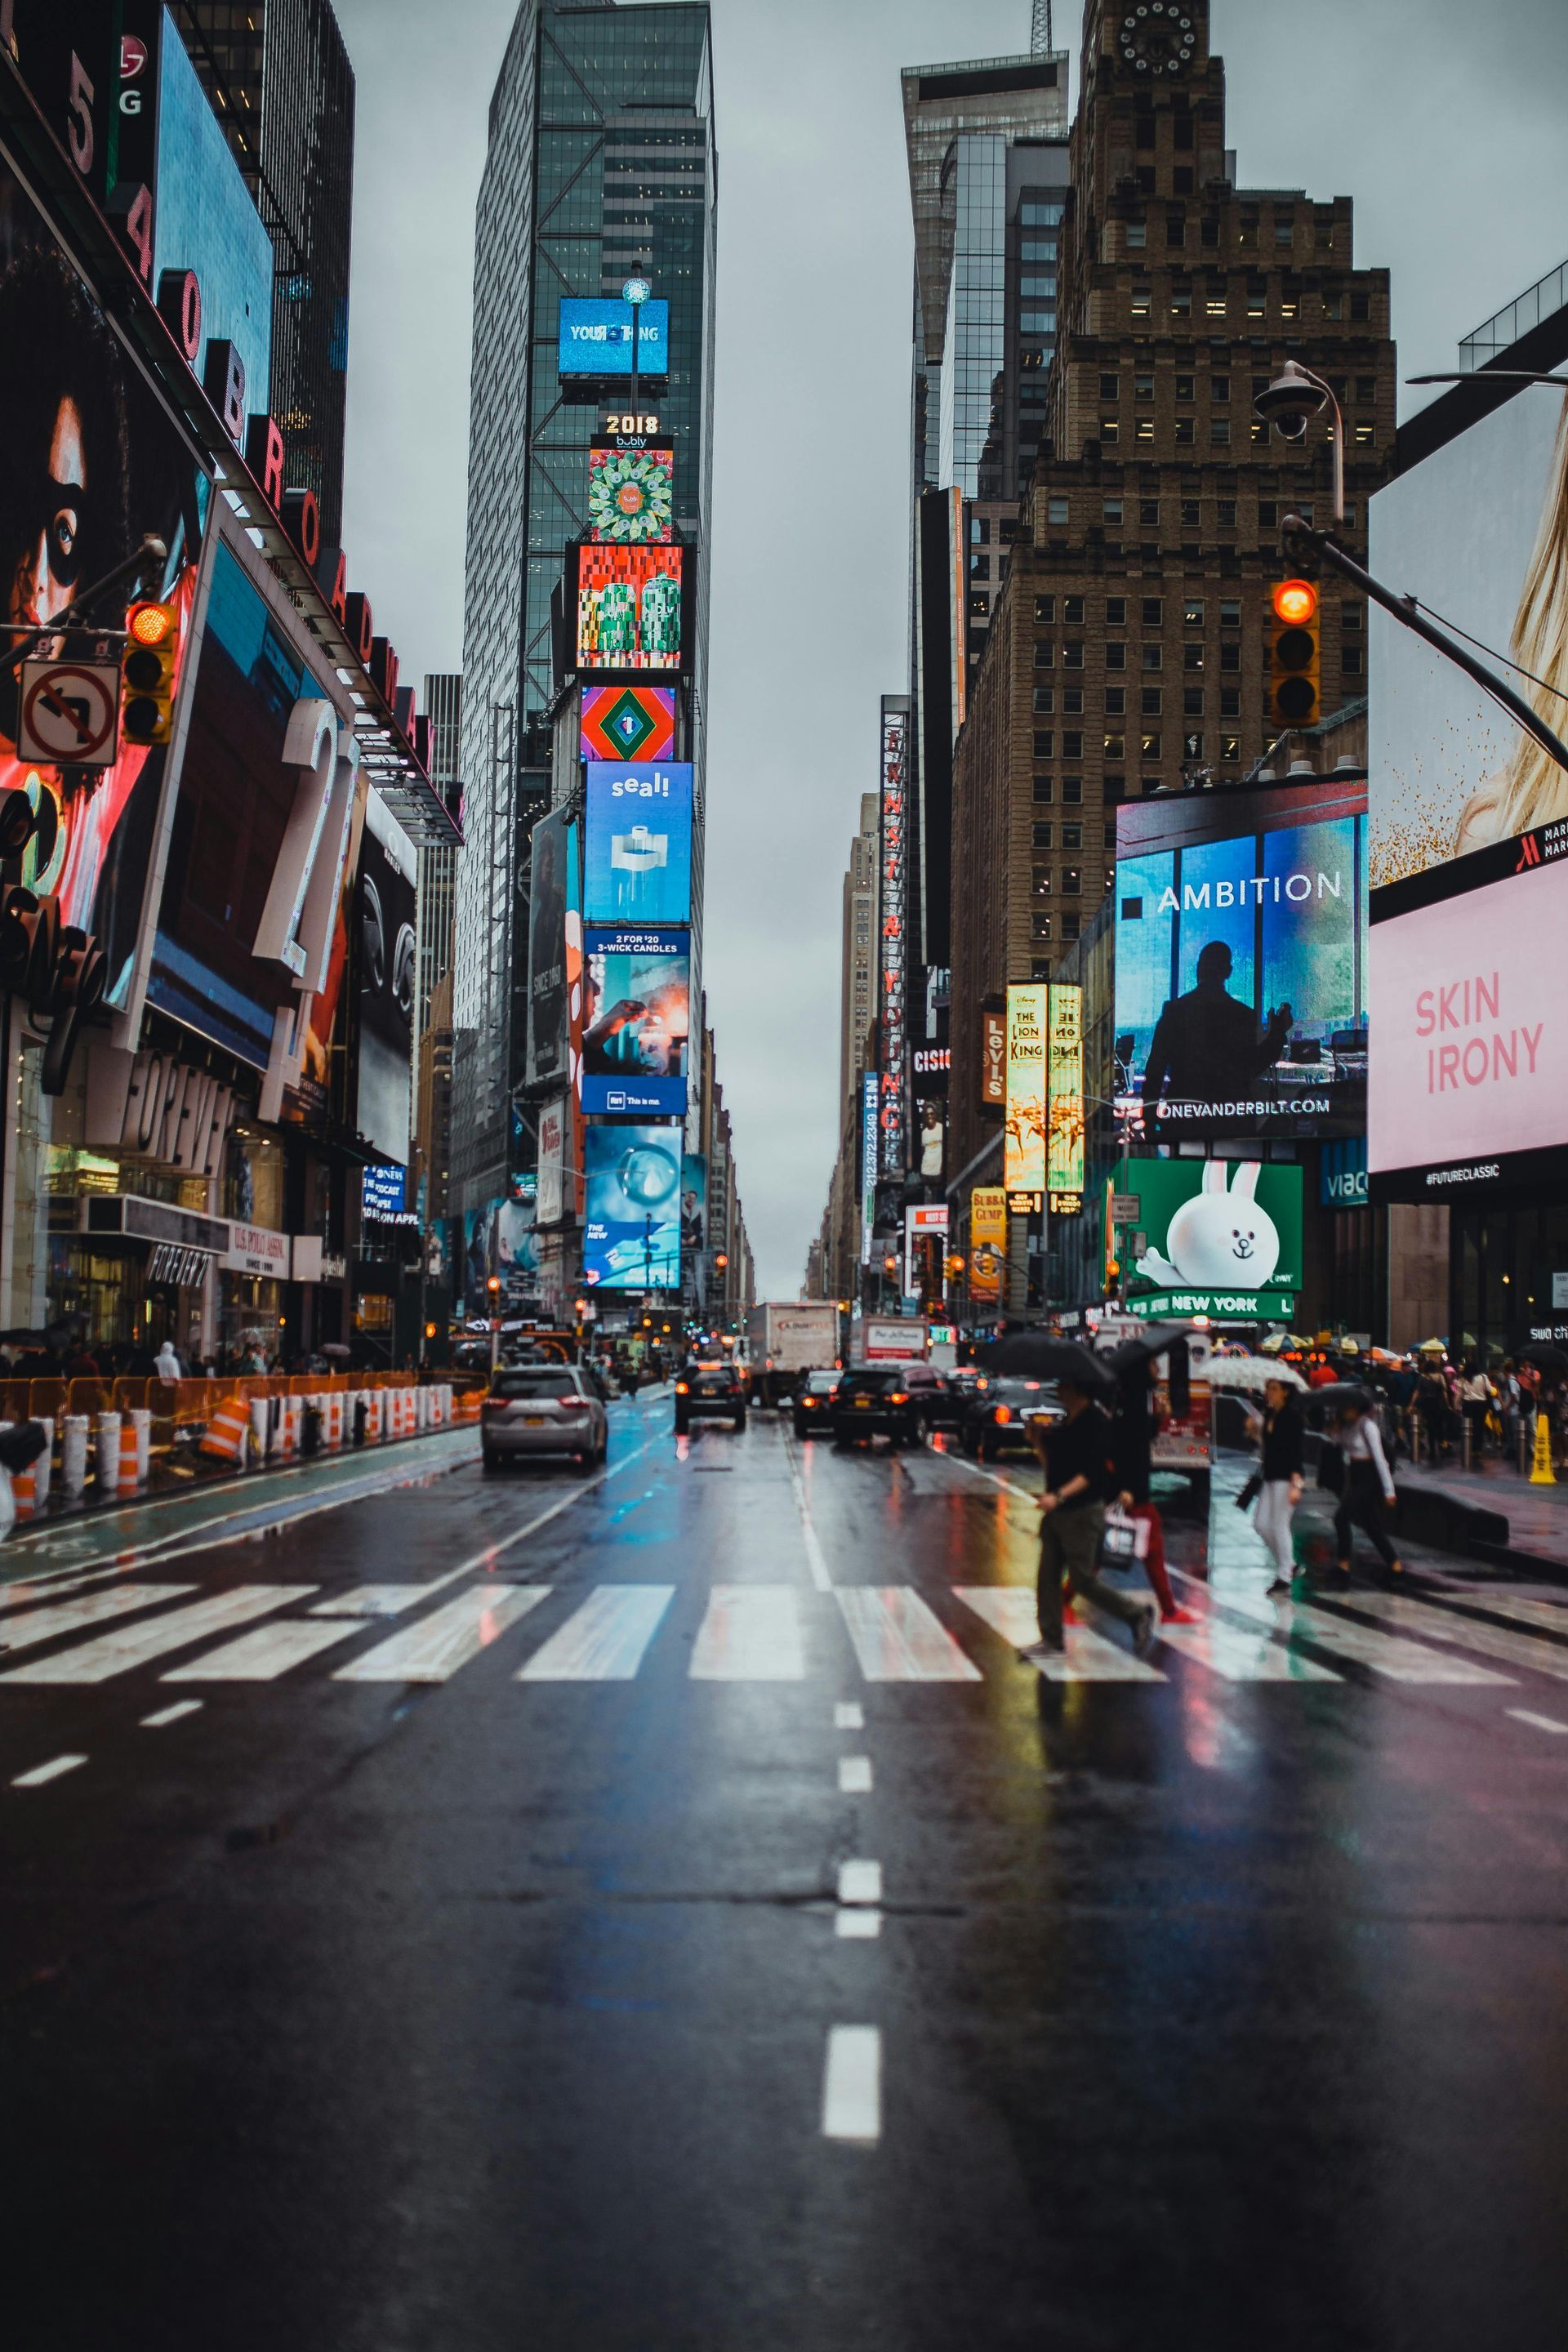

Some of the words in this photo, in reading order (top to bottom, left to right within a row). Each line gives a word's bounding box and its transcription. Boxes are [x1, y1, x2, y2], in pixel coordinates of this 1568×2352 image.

[621, 326, 658, 341] THNG
[607, 416, 657, 434] 2018
[612, 773, 669, 798] seal!
[884, 729, 902, 880] ERNST
[1157, 871, 1340, 913] AMBITION
[644, 935, 659, 943] $20
[1416, 972, 1499, 1037] SKIN
[1016, 1013, 1035, 1022] THE
[1013, 1024, 1039, 1040] LION
[1011, 1041, 1042, 1061] KING
[1428, 1023, 1544, 1094] IRONY
[1160, 1099, 1330, 1119] ONEVANDERBILT.COM
[866, 1113, 877, 1187] 212.372.2349
[1426, 1165, 1499, 1185] #FUTURECLASSIC
[973, 1193, 1004, 1206] BUBBA
[976, 1209, 1002, 1221] GUMP
[1172, 1296, 1209, 1311] NEW
[1214, 1297, 1258, 1312] YORK
[1530, 1325, 1568, 1340] swach
